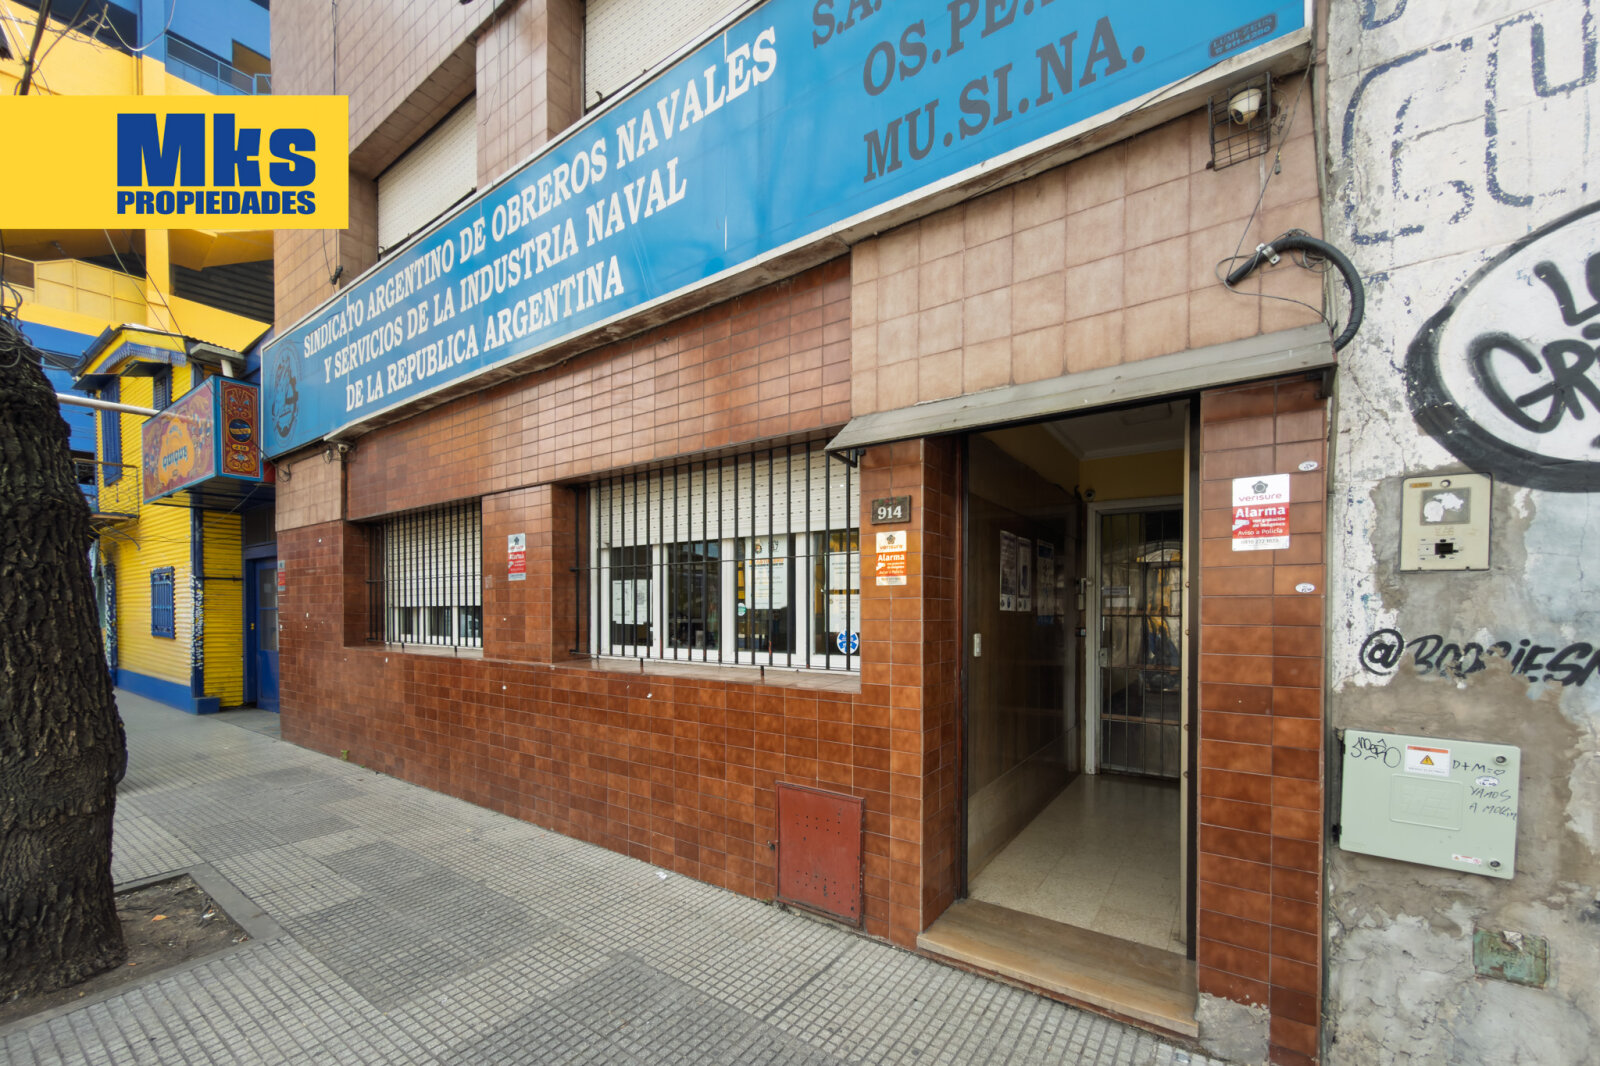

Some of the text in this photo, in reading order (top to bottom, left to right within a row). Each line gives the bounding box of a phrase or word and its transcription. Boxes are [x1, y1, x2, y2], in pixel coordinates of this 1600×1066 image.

[863, 0, 1051, 97] OS.PE.
[863, 16, 1146, 183] MU.SI.NA.
[304, 26, 777, 359] SINDICATO ARGENTINO DE OBREROS NAVALES
[324, 157, 687, 384] Y SERVICIOS DE LA INDUSTRIA NAVAL
[346, 255, 625, 413] DE LA REPUBLICA ARGENTINA
[877, 505, 902, 520] 914
[1235, 506, 1286, 518] Alarma
[1238, 493, 1283, 502] verisure
[878, 554, 905, 562] Alarma
